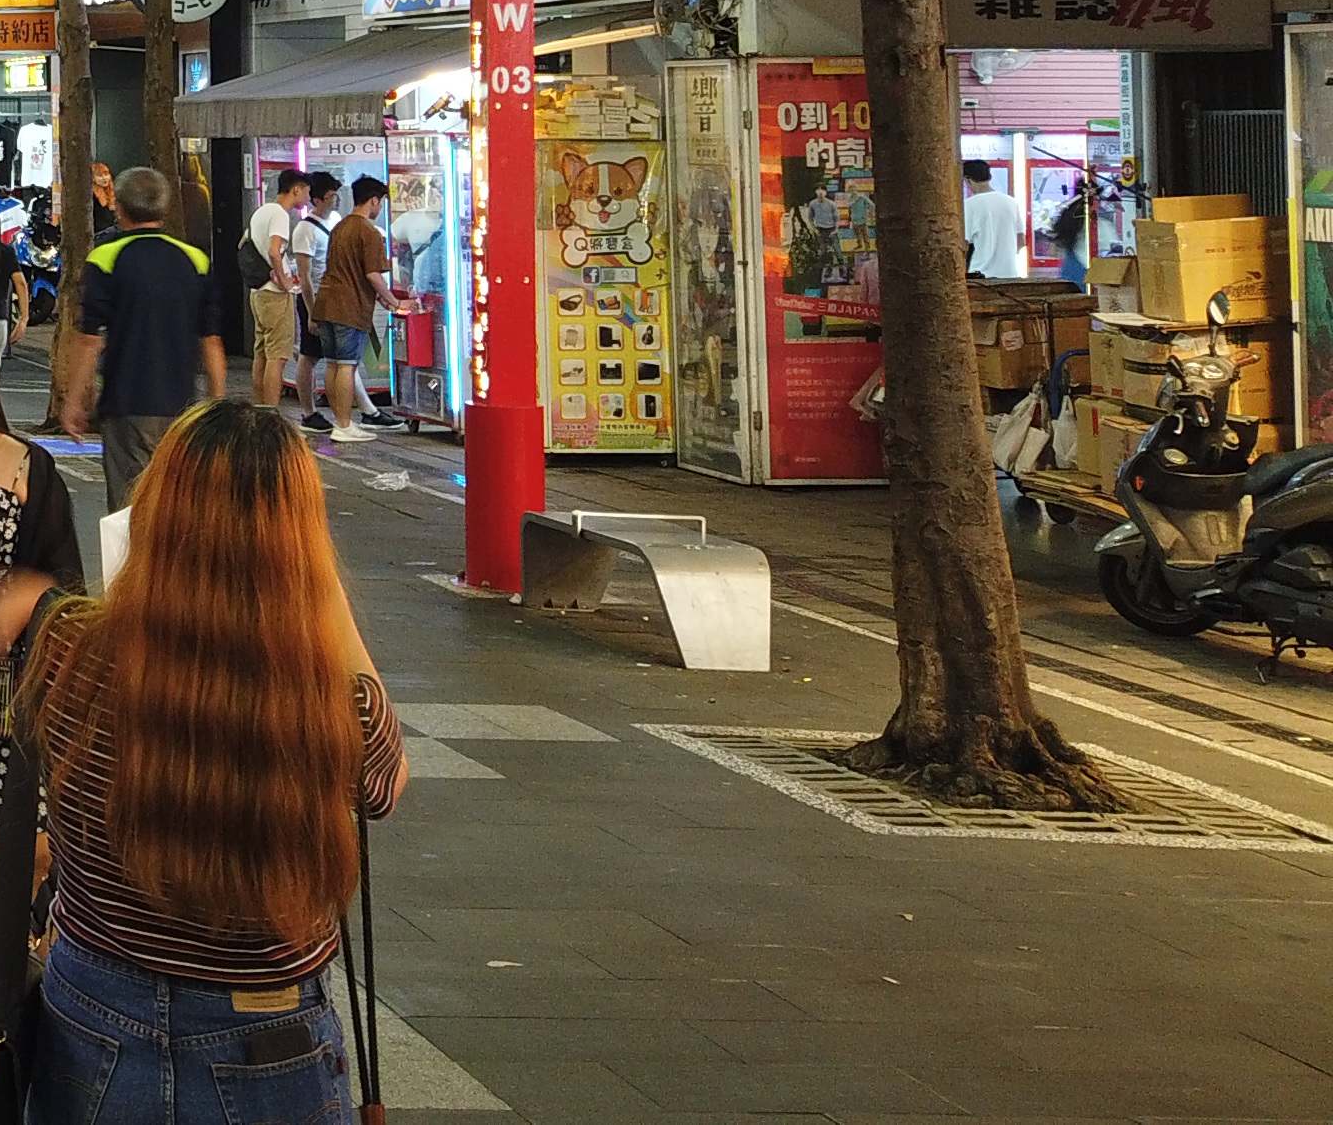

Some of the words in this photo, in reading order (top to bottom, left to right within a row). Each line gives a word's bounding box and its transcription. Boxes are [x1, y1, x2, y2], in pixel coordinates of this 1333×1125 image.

[493, 3, 528, 32] W
[491, 67, 530, 93] 03
[329, 142, 356, 155] HO
[806, 138, 871, 169] 的奇
[1093, 144, 1106, 155] HO
